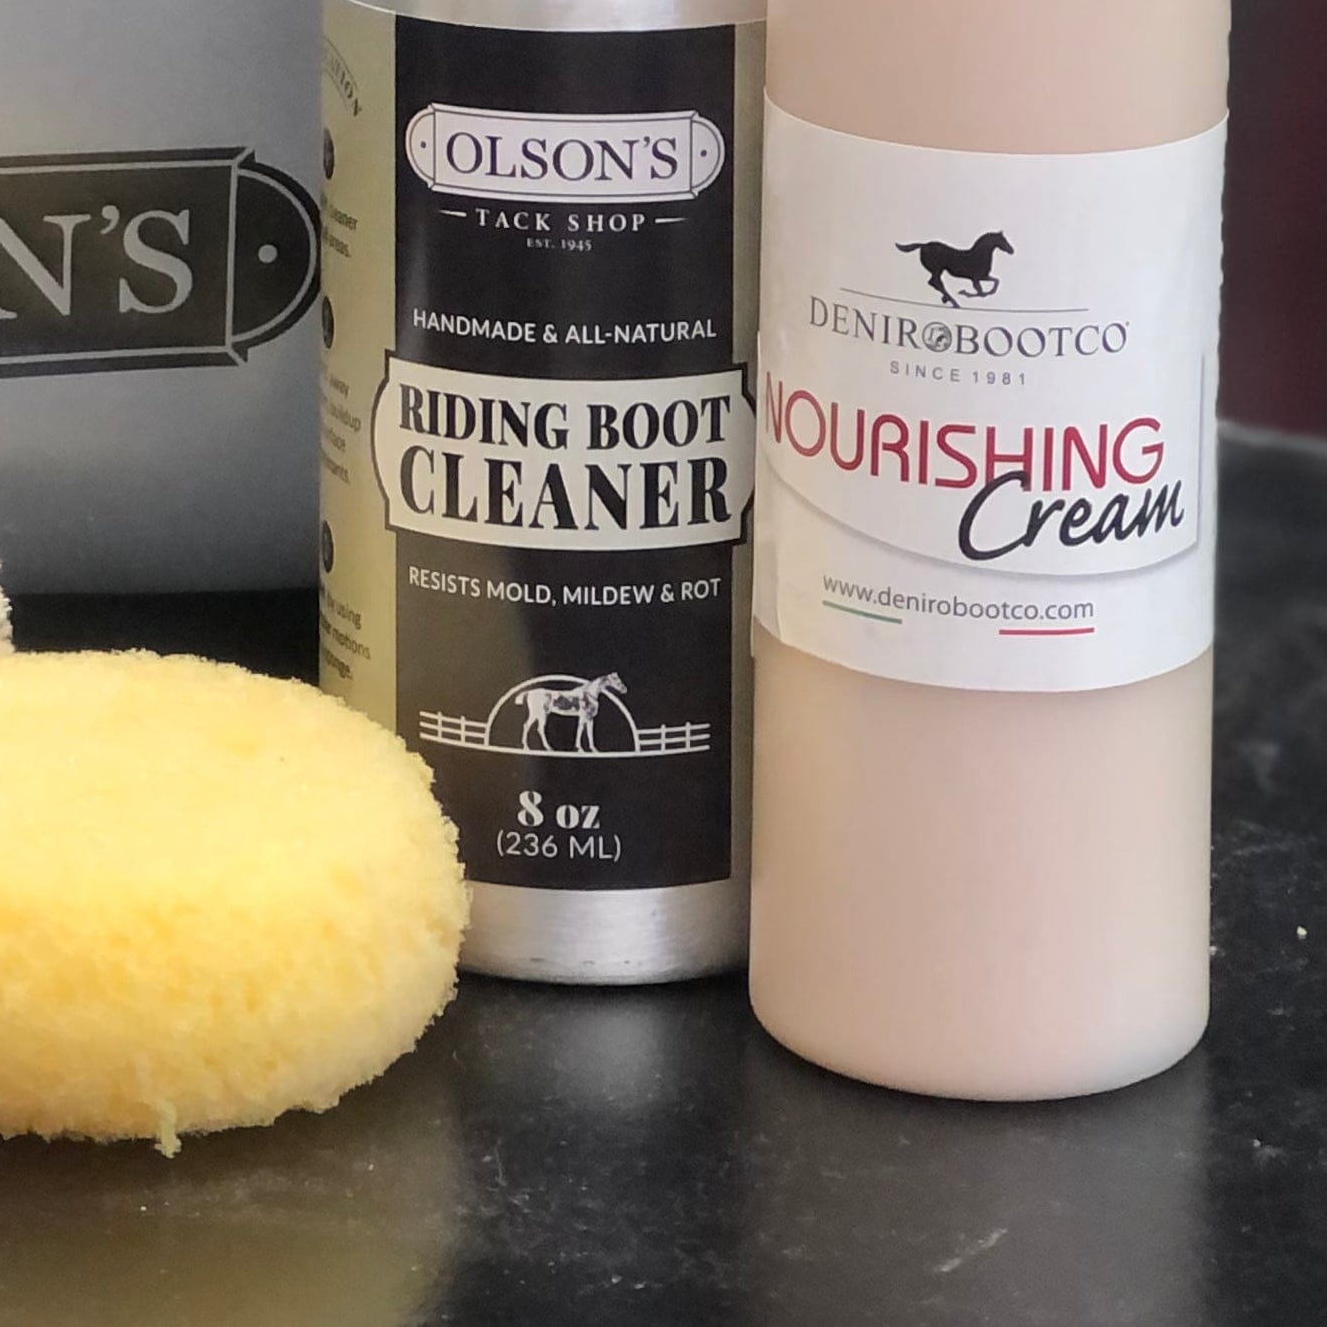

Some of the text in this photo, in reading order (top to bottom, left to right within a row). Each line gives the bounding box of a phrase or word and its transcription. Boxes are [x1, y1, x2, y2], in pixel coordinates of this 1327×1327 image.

[446, 132, 678, 181] OLSON'S
[476, 208, 646, 233] TACK SHOP
[526, 237, 592, 251] EST. 1945
[413, 307, 717, 344] HANDMADE & ALL-NATURAL
[890, 360, 1026, 386] SINCE 1981
[399, 382, 570, 449] RIDING
[586, 395, 730, 450] BOOT
[764, 371, 1164, 492] NOURISHING
[399, 444, 732, 531] CLEANER
[958, 470, 1185, 561] Cream
[409, 566, 722, 606] RESISTS MOLD, MILDEW & ROT
[823, 575, 1094, 620] www.denirobootco.com
[517, 790, 600, 829] 8 oz
[496, 830, 621, 861] (236 ML)
